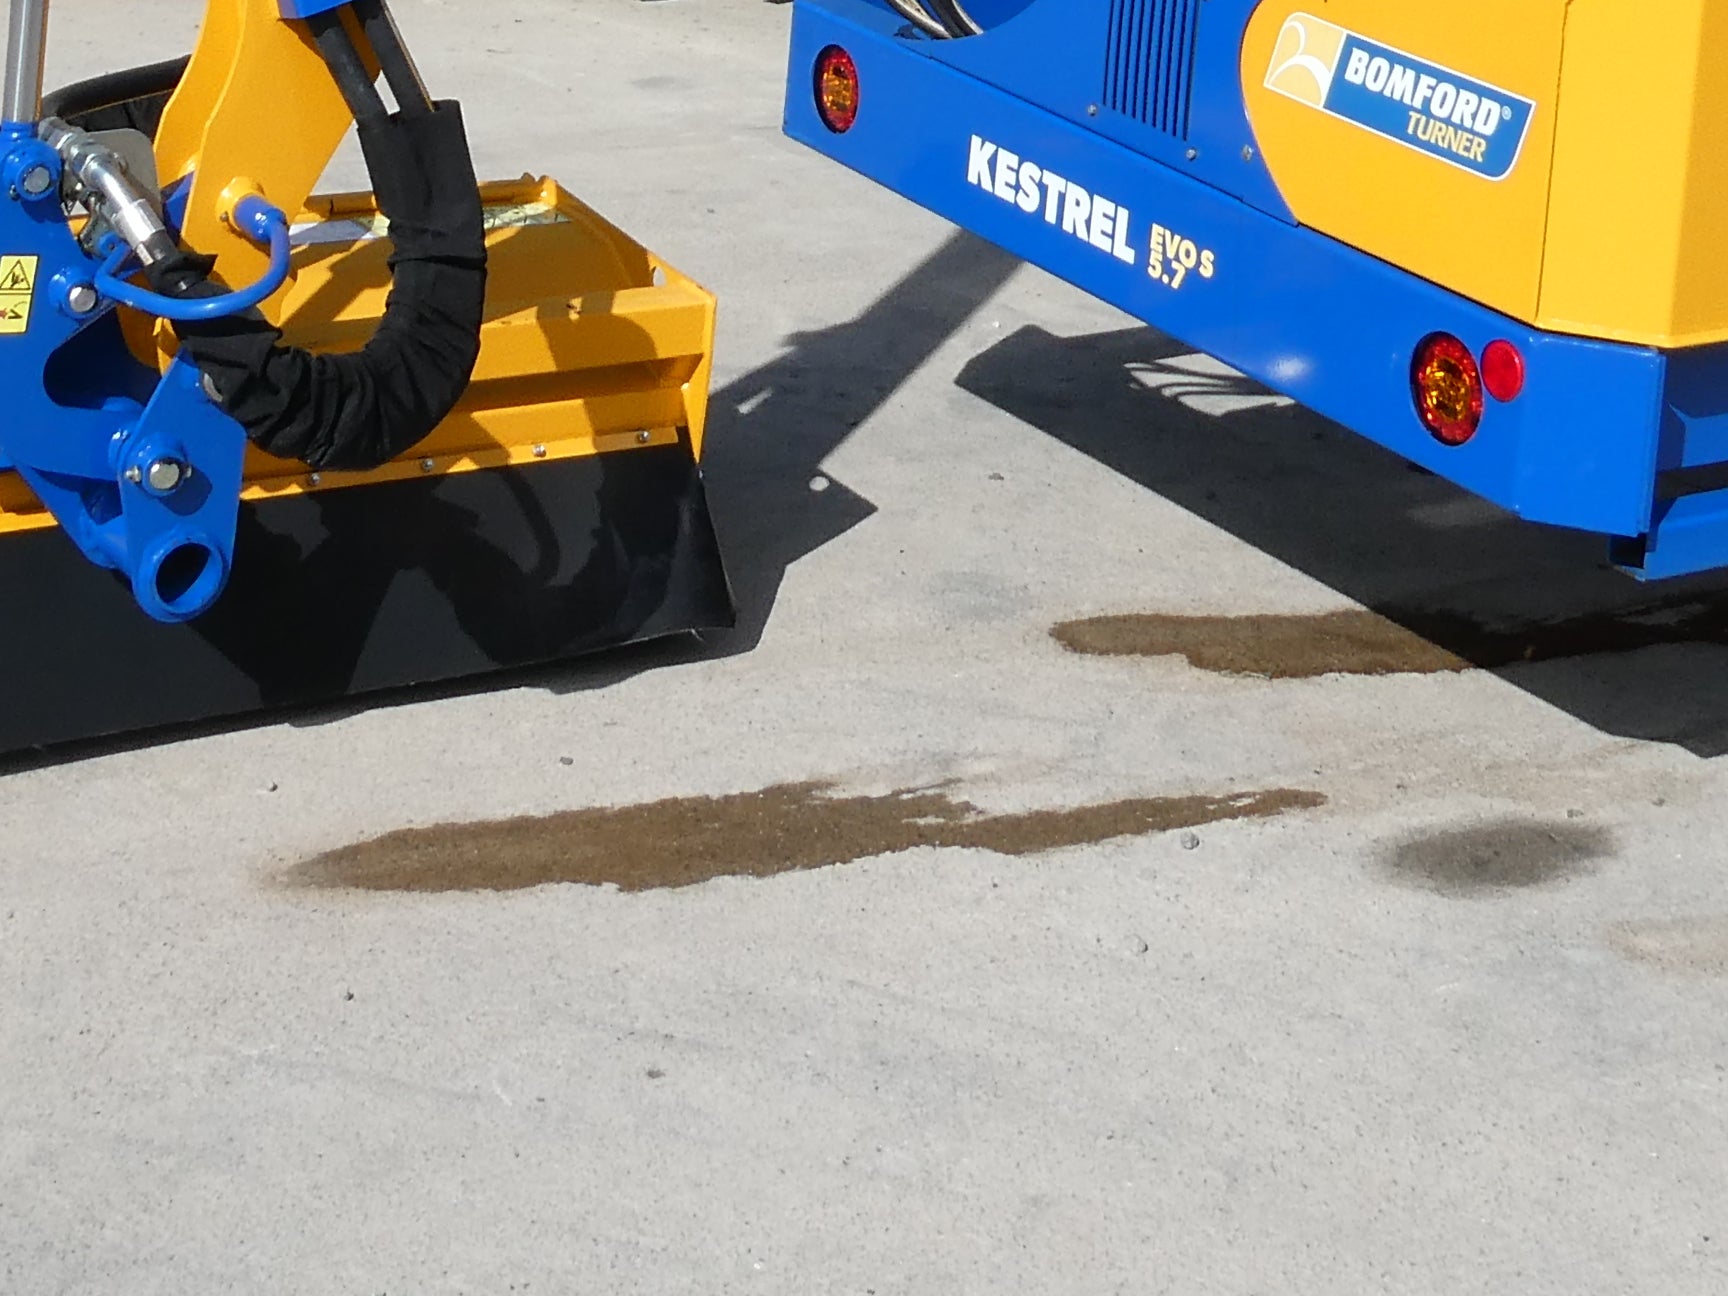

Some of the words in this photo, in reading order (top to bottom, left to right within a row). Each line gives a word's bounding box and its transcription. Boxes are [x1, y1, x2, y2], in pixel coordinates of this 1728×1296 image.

[1344, 47, 1502, 137] BOMFORD
[1404, 110, 1488, 163] TURNER
[967, 134, 1135, 265] KESTREL
[1147, 250, 1187, 290] 5.7
[1149, 222, 1198, 270] EVO
